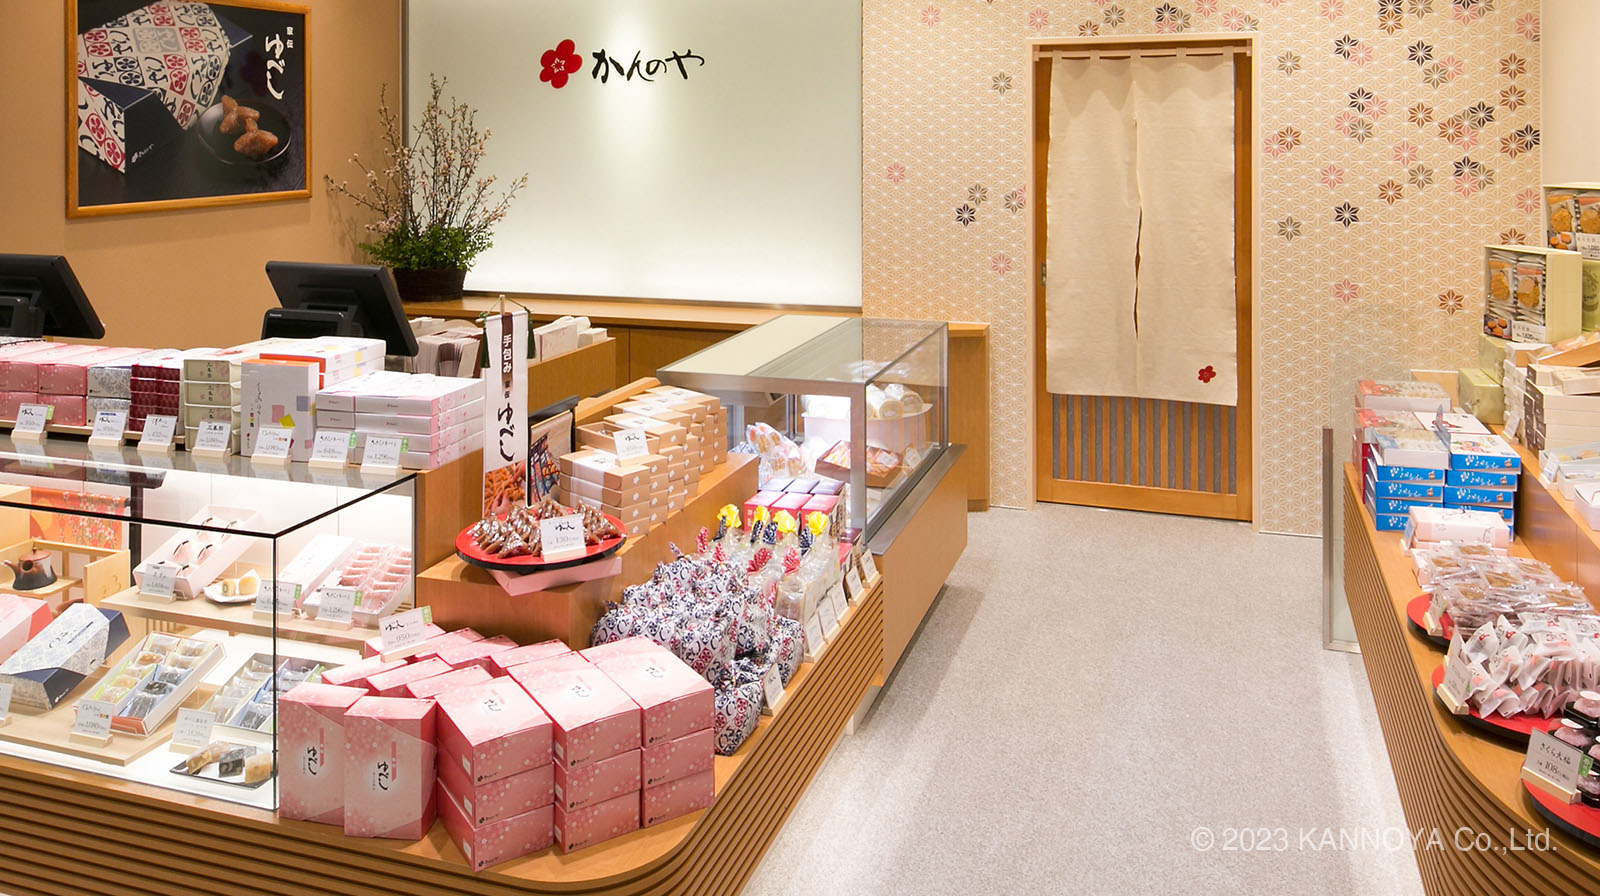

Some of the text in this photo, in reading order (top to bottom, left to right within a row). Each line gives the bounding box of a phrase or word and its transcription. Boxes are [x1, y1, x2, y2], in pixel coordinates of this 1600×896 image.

[265, 33, 286, 100] ゆべし
[592, 48, 706, 84] かんのや
[497, 402, 515, 462] ゆべし
